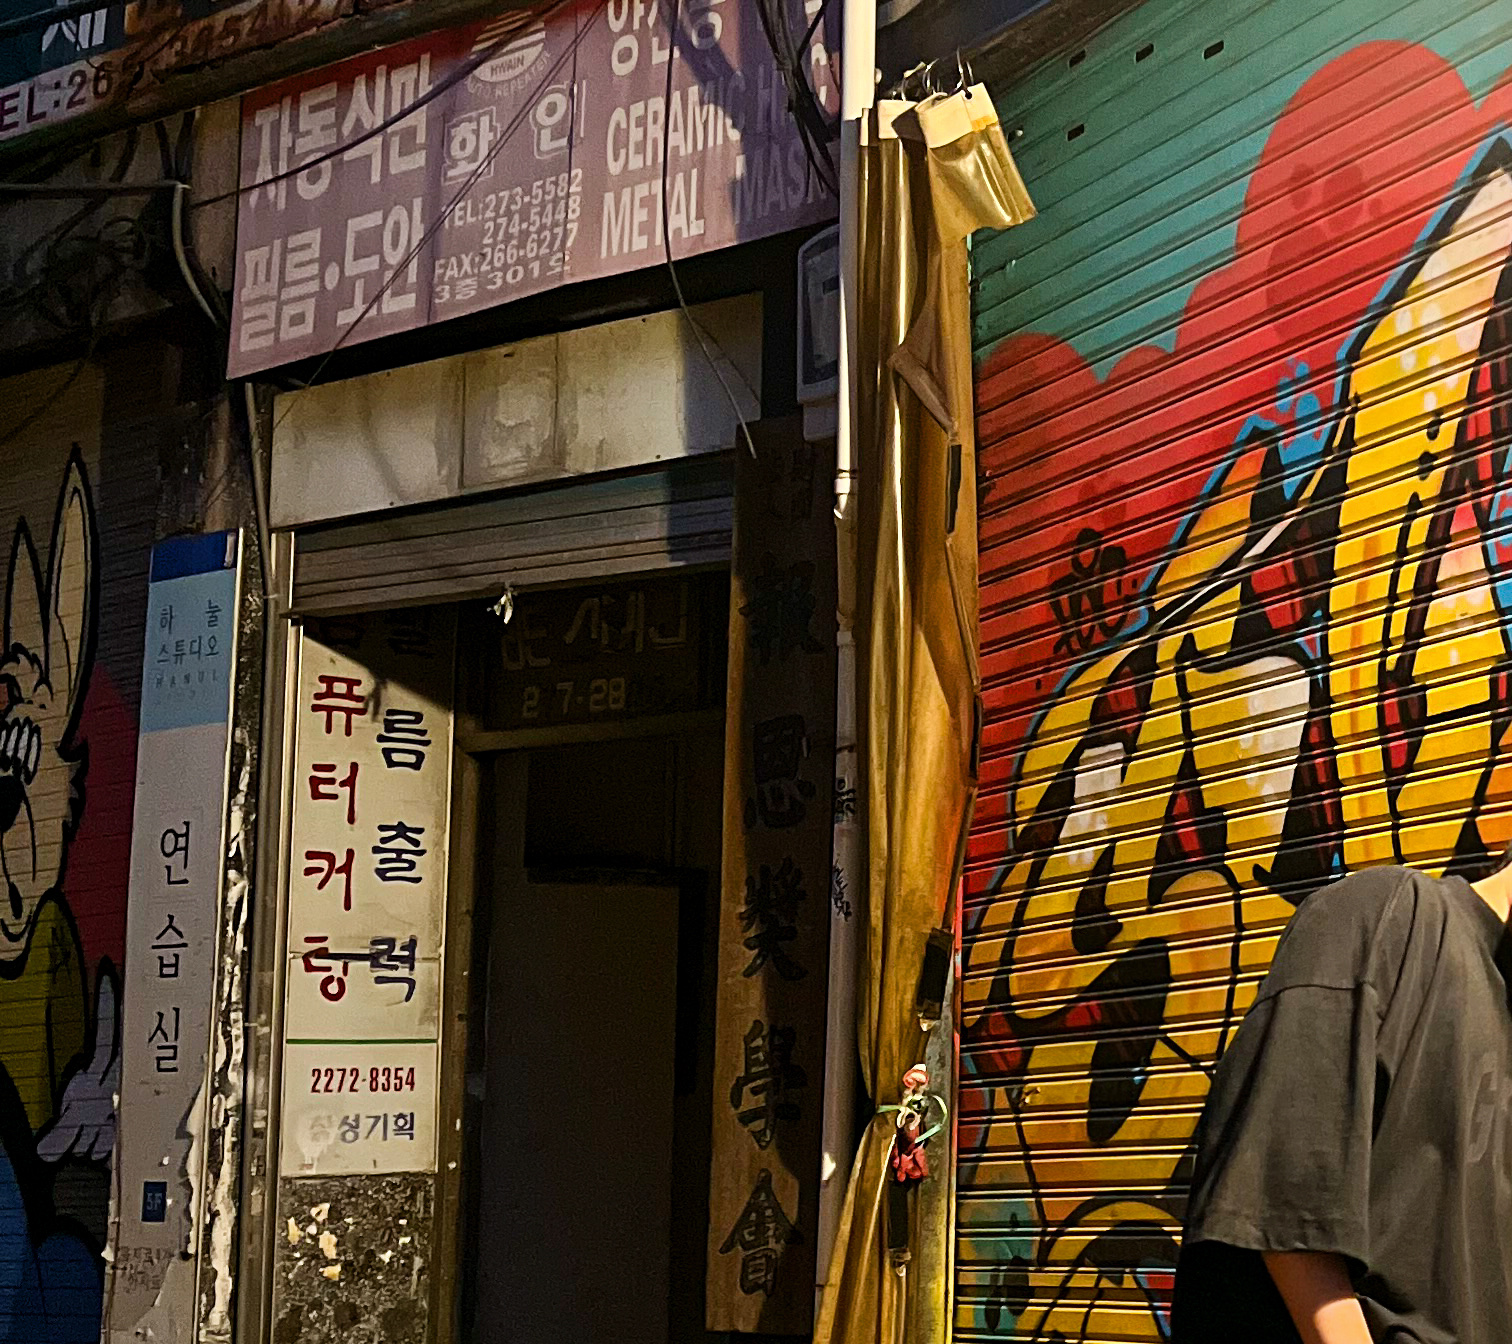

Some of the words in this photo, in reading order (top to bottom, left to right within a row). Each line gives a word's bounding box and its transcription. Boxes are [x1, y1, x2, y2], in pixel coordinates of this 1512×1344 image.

[606, 70, 746, 176] CERAMIC
[482, 195, 581, 245] 274-5448
[600, 168, 705, 259] METAL
[434, 222, 578, 283] FAX:266-6277
[156, 634, 220, 665] 스튜디오
[147, 820, 191, 1073] 연습실
[310, 1111, 415, 1144] 성기획
